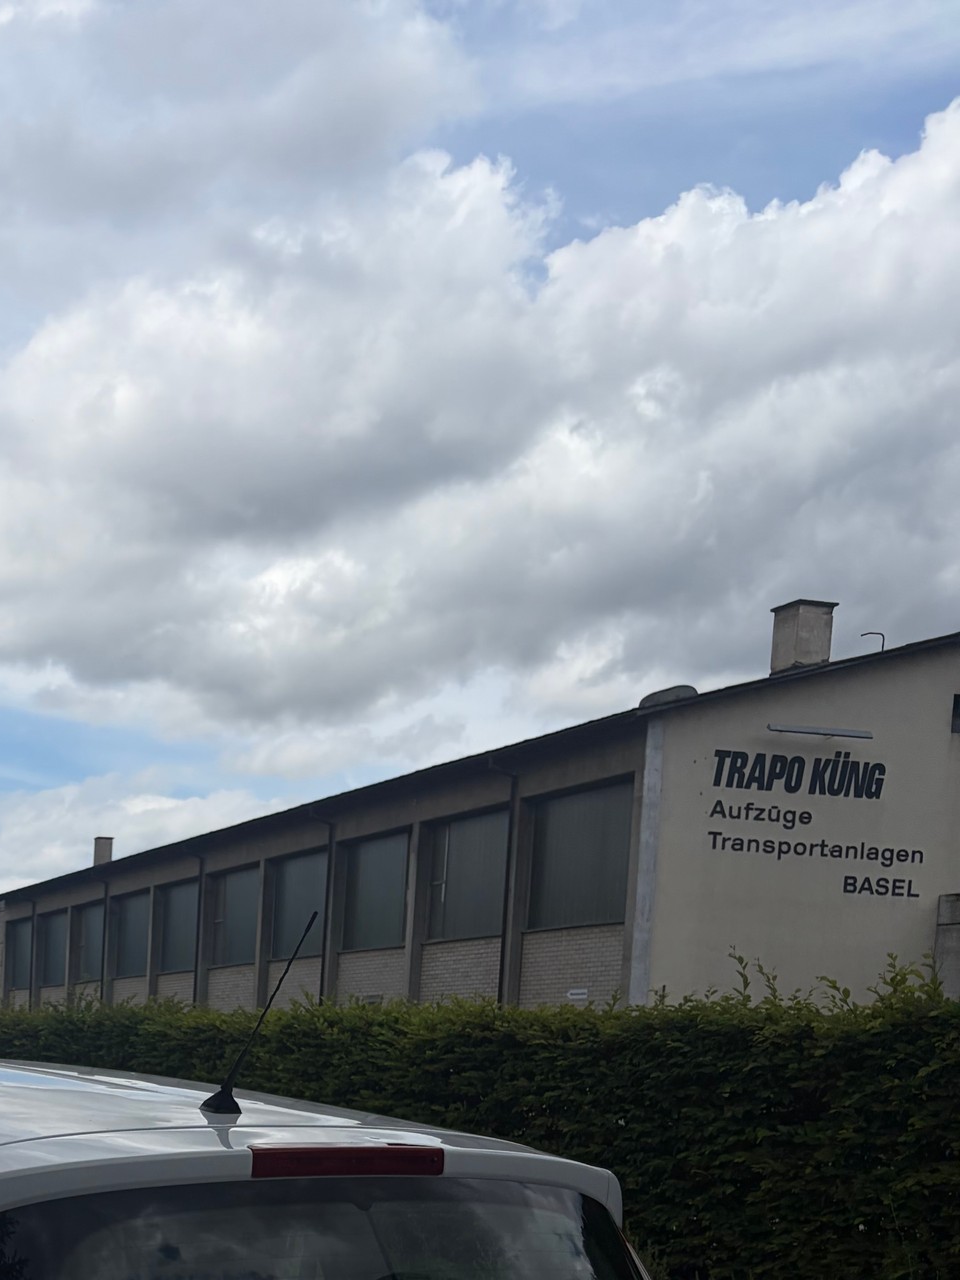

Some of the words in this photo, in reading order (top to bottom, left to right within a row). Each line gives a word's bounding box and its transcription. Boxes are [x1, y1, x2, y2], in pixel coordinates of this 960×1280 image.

[713, 749, 806, 794] TRAPO
[808, 751, 886, 800] KÜNG
[709, 800, 813, 830] Aufzüge
[708, 831, 924, 867] Transportanlagen
[842, 875, 920, 898] BASEL
